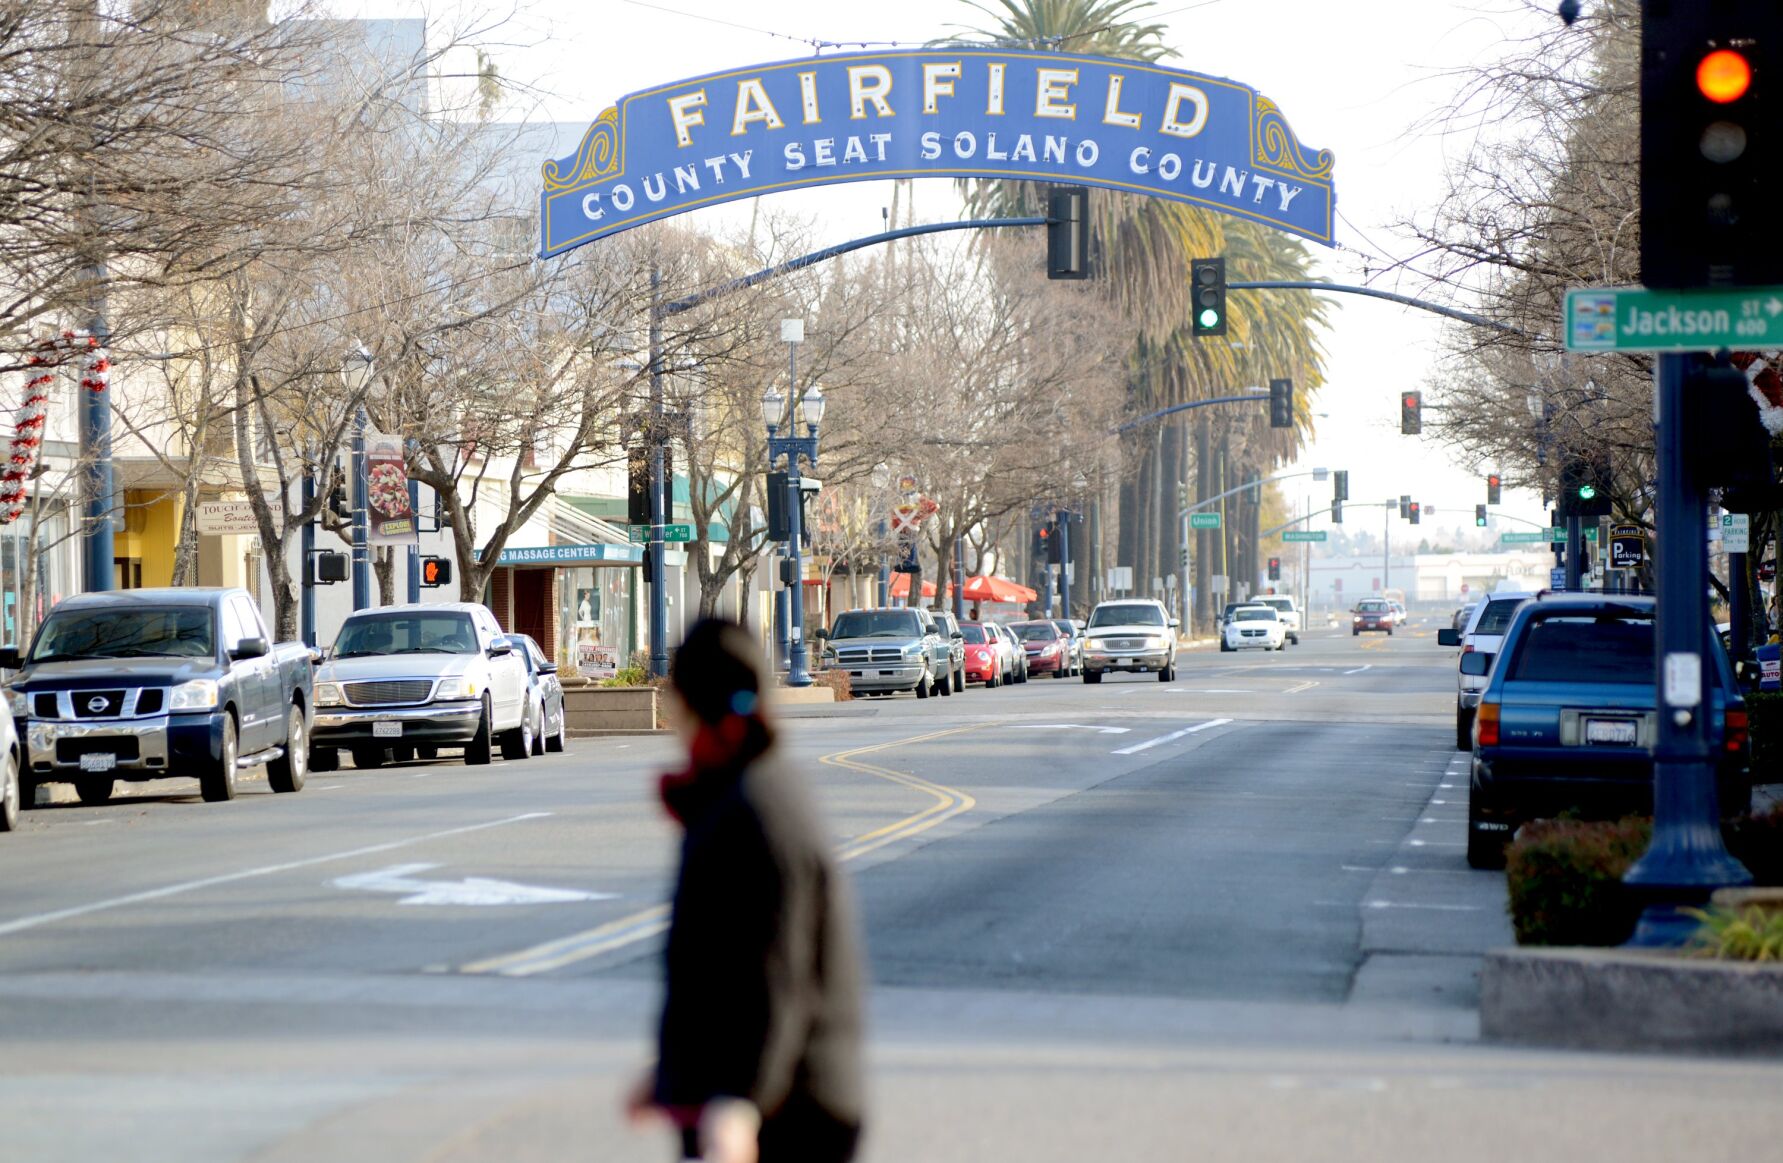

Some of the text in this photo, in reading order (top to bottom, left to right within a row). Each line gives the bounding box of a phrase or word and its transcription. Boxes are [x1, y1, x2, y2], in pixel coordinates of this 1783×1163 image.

[667, 61, 1210, 147] FAIRFIELD
[582, 131, 1302, 220] COUNTY SEAT SOLANO COUNTY
[1623, 300, 1760, 336] Jackson ST
[1736, 319, 1767, 336] 600
[1194, 516, 1217, 525] Union
[1725, 516, 1731, 525] 2
[1724, 527, 1747, 536] PARKING
[509, 549, 555, 561] MASSAGE
[558, 547, 596, 558] CENTER
[1613, 542, 1641, 560] Parking
